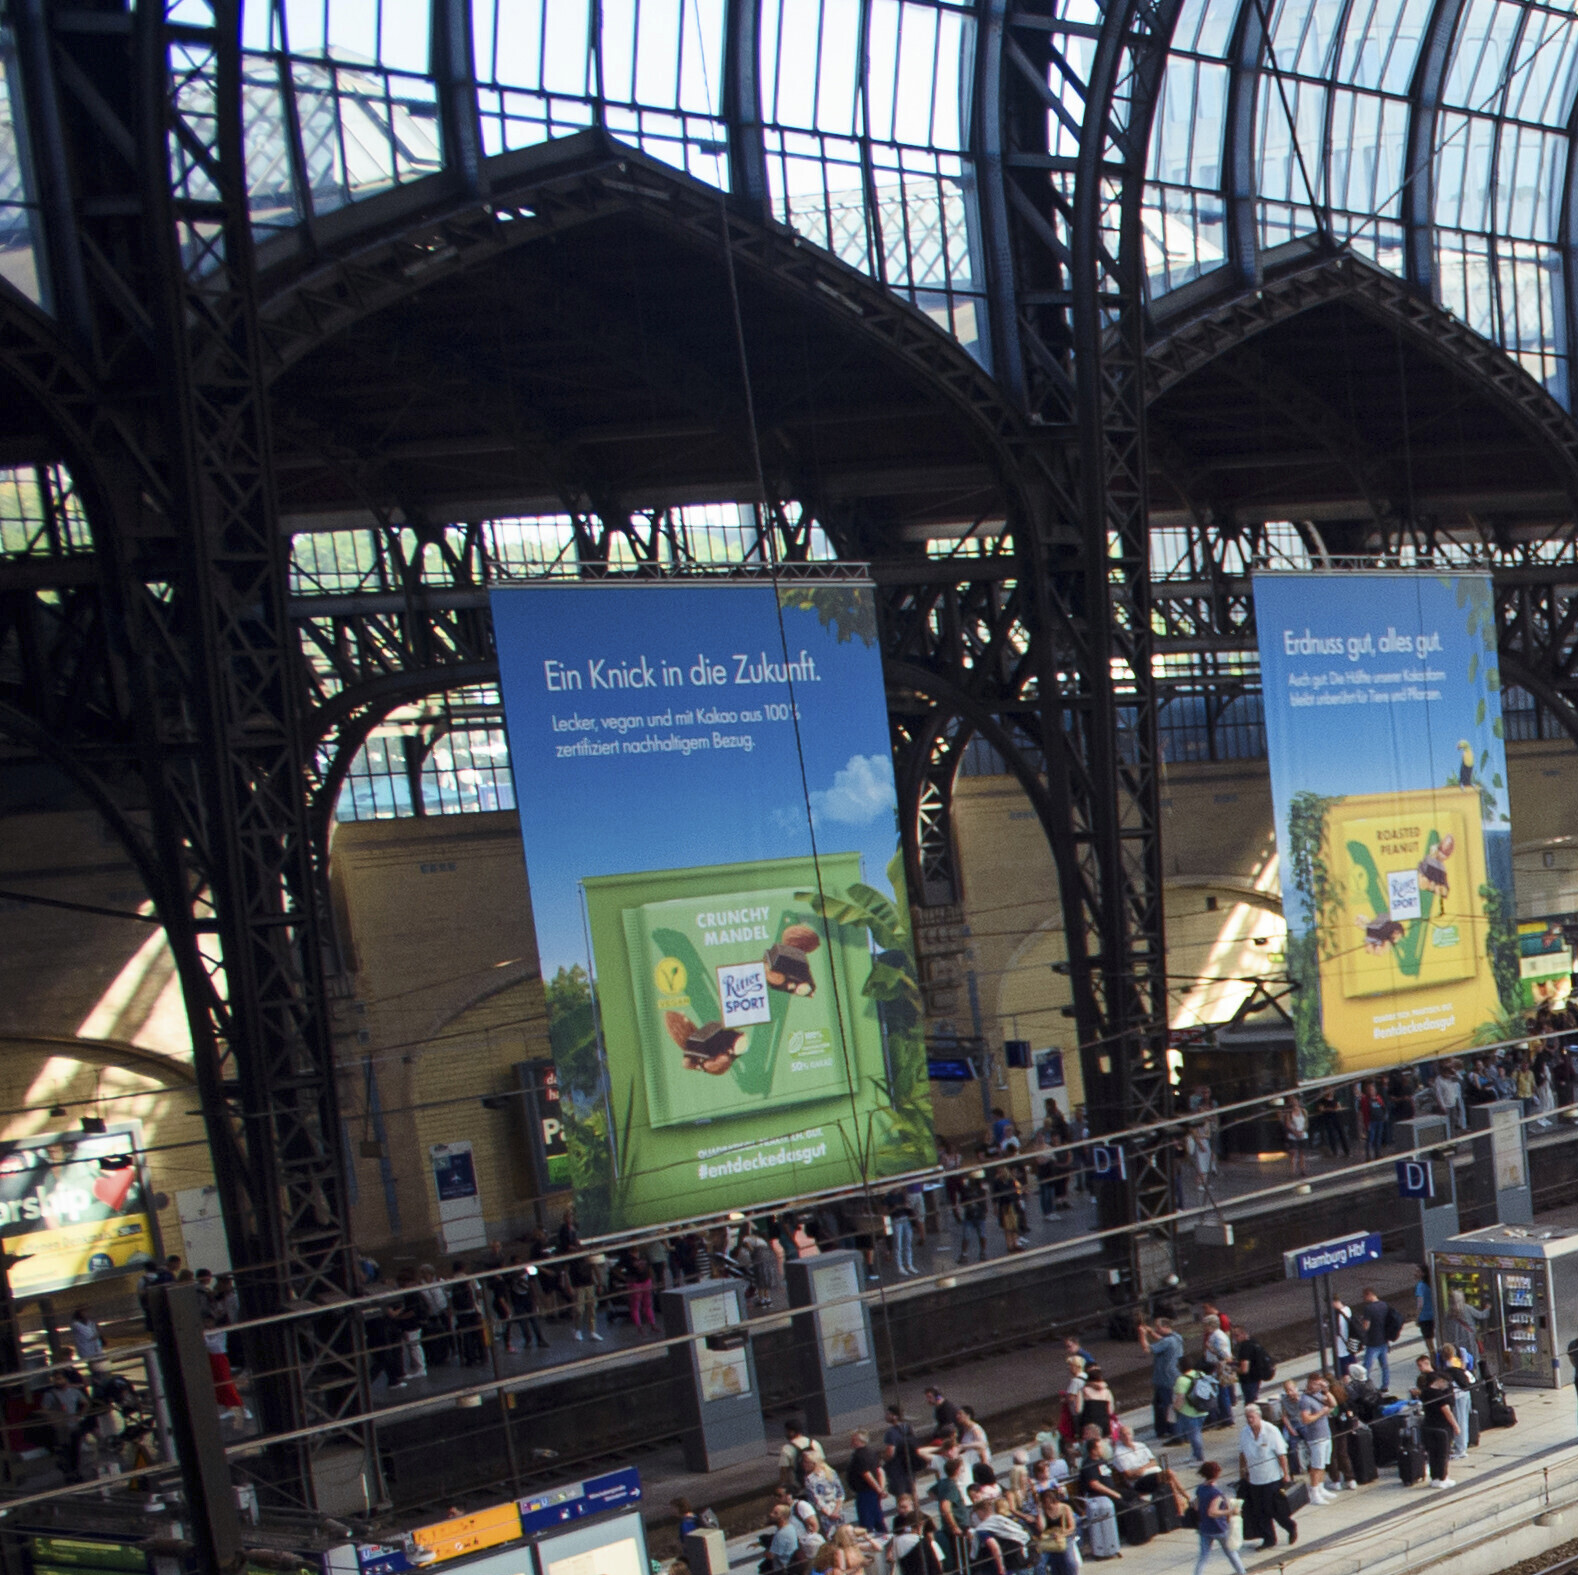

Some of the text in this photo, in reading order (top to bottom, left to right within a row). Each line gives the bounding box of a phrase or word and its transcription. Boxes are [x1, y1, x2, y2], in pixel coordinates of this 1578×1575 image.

[1283, 627, 1444, 662] Erdnuss gut, alles gut.
[544, 649, 821, 691] Ein Knick in die Zukunft.
[552, 707, 762, 734] Lecker, vegan und mit Kakao aus
[556, 731, 755, 758] zertifiziert nachhaltigem Bezug.
[1376, 827, 1421, 841] ROASTED
[1380, 841, 1419, 855] PEANUT
[1392, 897, 1418, 910] SPORT
[696, 906, 770, 929] CRUNCHY
[704, 925, 769, 947] MANDEL
[722, 972, 763, 999] Ritter
[725, 996, 765, 1014] SPORT
[698, 1142, 827, 1180] #entdeckedasgut
[1094, 1147, 1111, 1174] D
[1406, 1162, 1425, 1190] D
[1303, 1240, 1366, 1271] Hamburg Hbf
